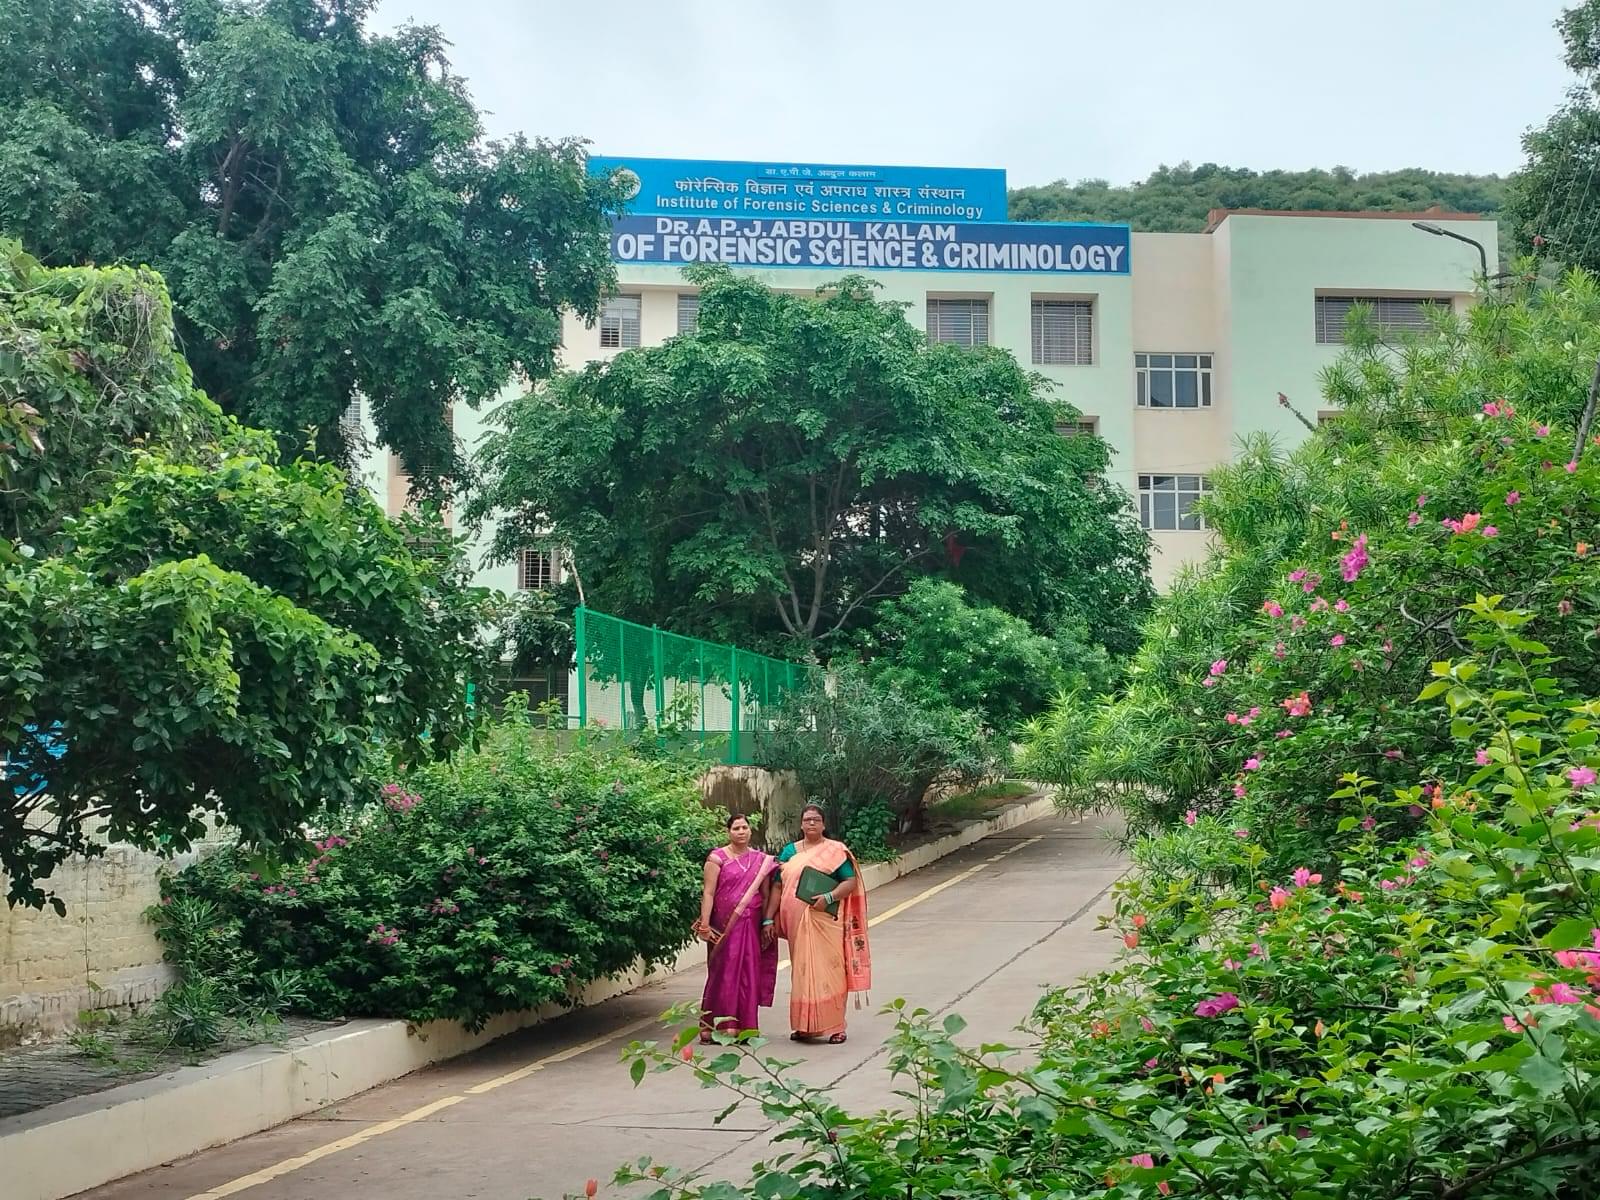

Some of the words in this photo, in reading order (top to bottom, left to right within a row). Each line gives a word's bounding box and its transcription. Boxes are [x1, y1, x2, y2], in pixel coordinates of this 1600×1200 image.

[745, 179, 787, 195] विज्ञान
[795, 181, 816, 196] एवं
[820, 183, 866, 198] अपराध
[874, 186, 911, 199] शास्त्र
[918, 184, 965, 200] संस्थान
[656, 195, 718, 209] Institute
[723, 197, 739, 210] of
[743, 198, 806, 212] Forensic
[811, 200, 877, 214] Sciences
[882, 202, 892, 214] &
[896, 202, 983, 219] Criminology
[865, 223, 956, 241] KALAM
[617, 234, 655, 260] OF
[663, 235, 801, 264] FORENSIC
[809, 239, 917, 268] SCIENCE
[921, 241, 939, 267] &
[943, 243, 1125, 271] CRIMINOLOGY
